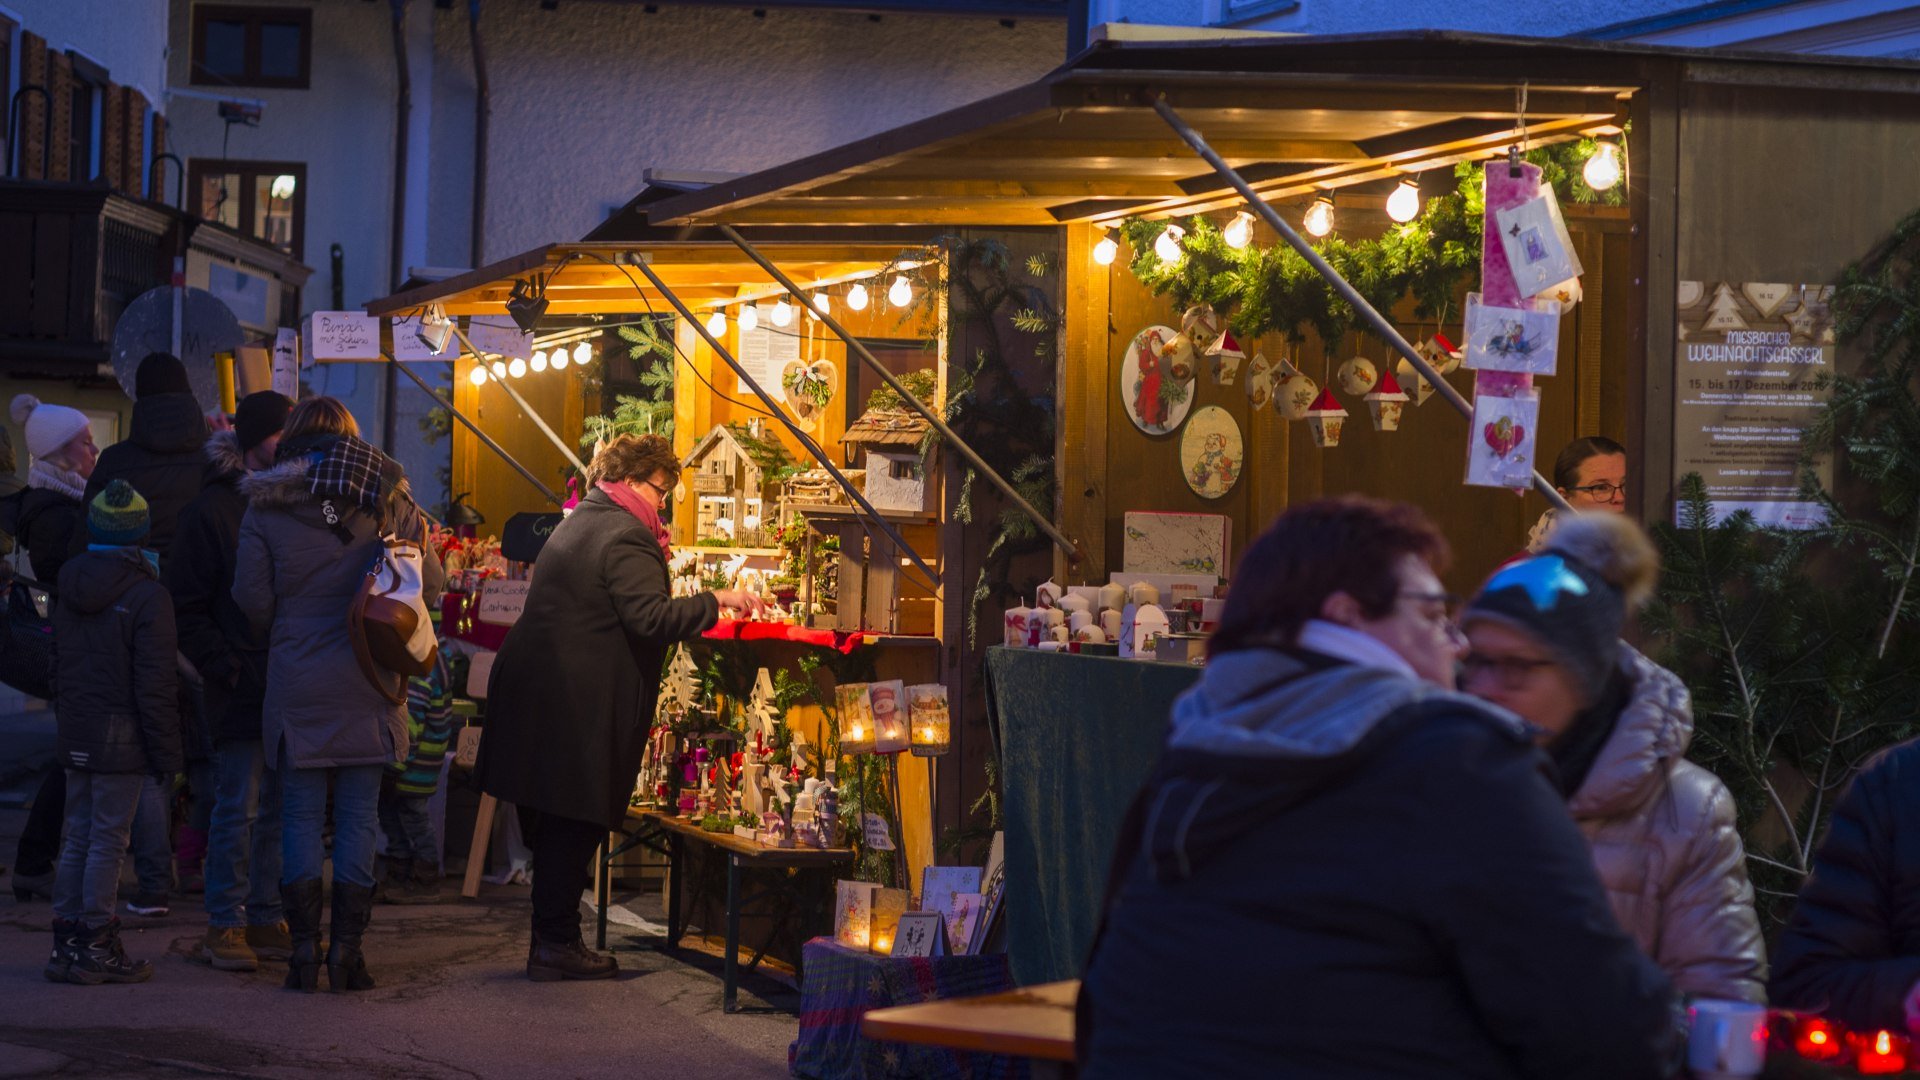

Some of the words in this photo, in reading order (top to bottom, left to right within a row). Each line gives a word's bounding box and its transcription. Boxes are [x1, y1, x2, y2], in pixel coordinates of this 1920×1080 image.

[1727, 331, 1791, 345] MIESBACHER
[1688, 345, 1826, 364] WEIHNACHTSGASSERL
[1708, 379, 1724, 389] bis
[1745, 379, 1798, 391] Dezember
